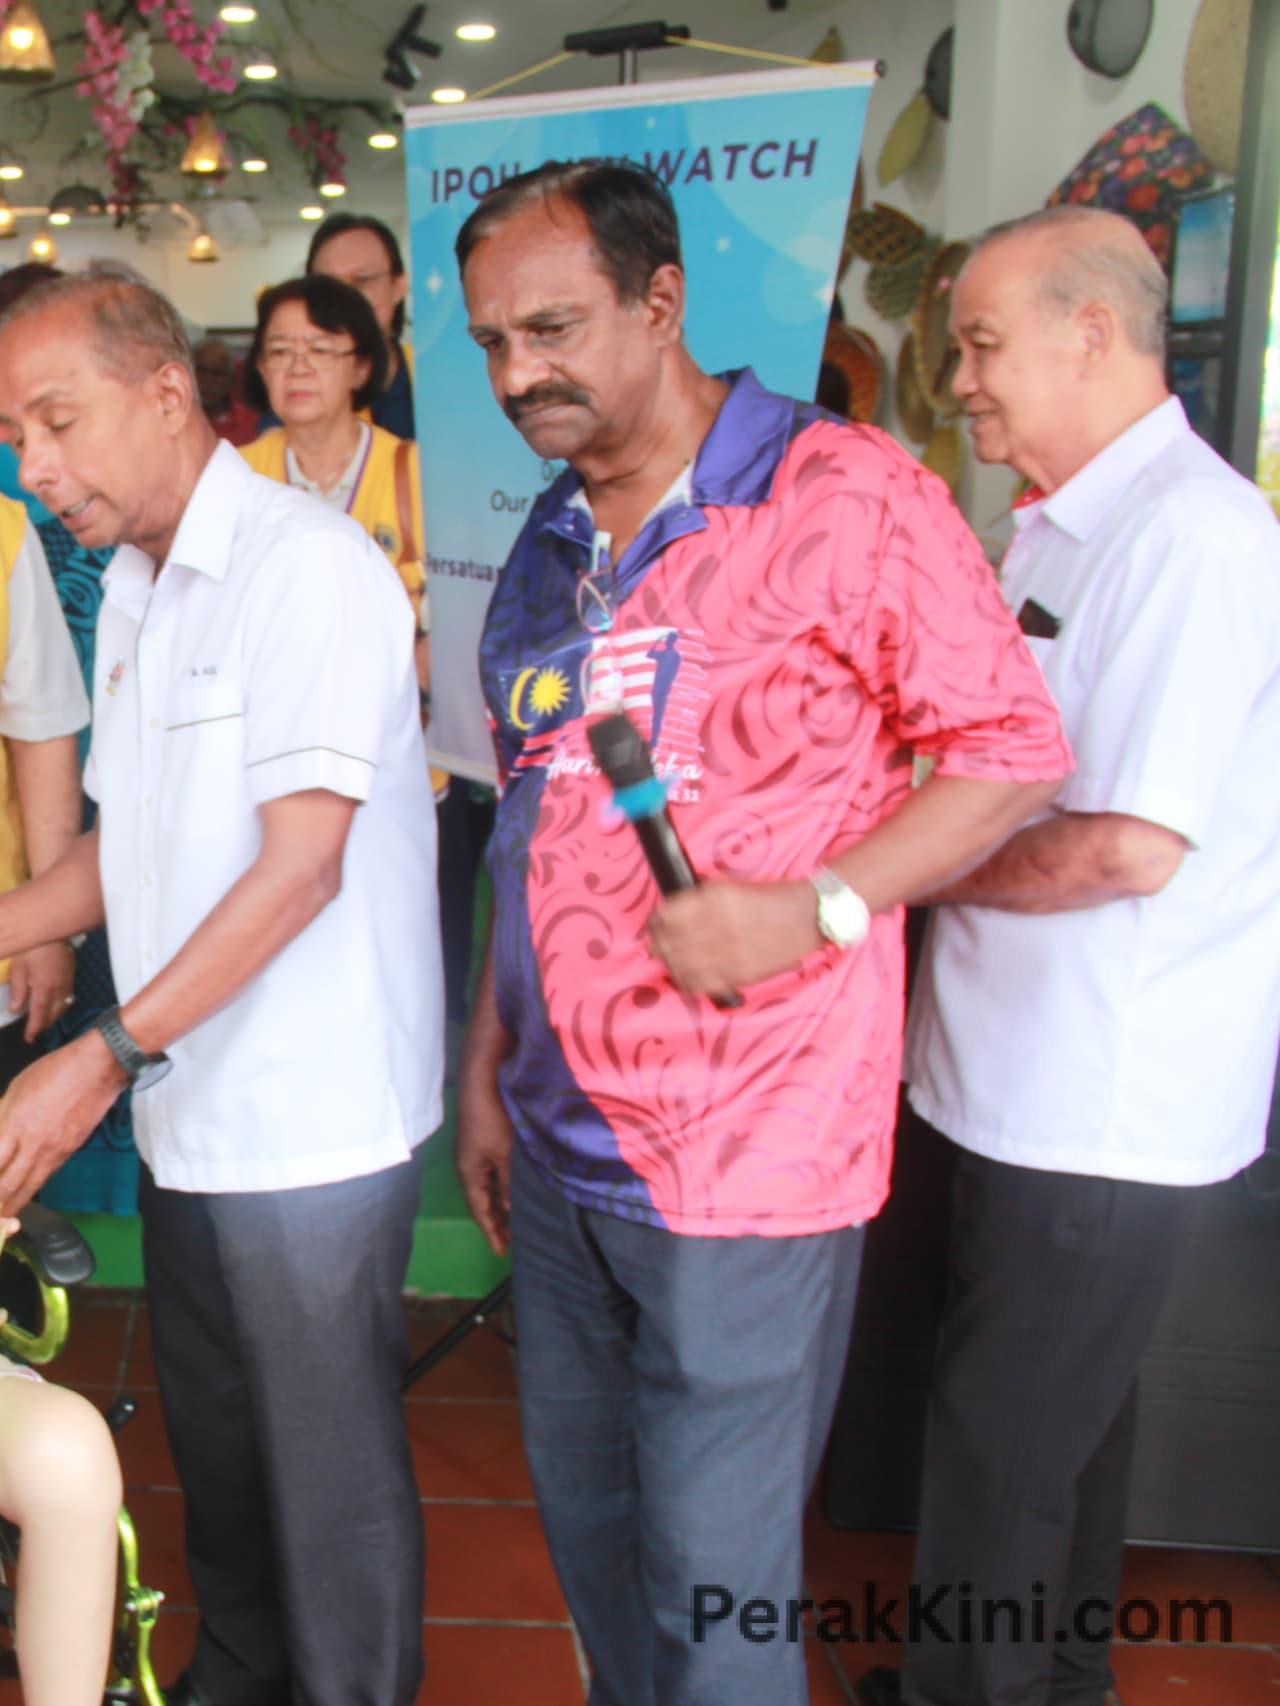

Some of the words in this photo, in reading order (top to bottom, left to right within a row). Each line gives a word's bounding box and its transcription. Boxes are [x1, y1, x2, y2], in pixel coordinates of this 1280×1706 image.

[643, 138, 818, 185] WATCH
[491, 490, 528, 512] Our
[426, 553, 500, 582] ersatua
